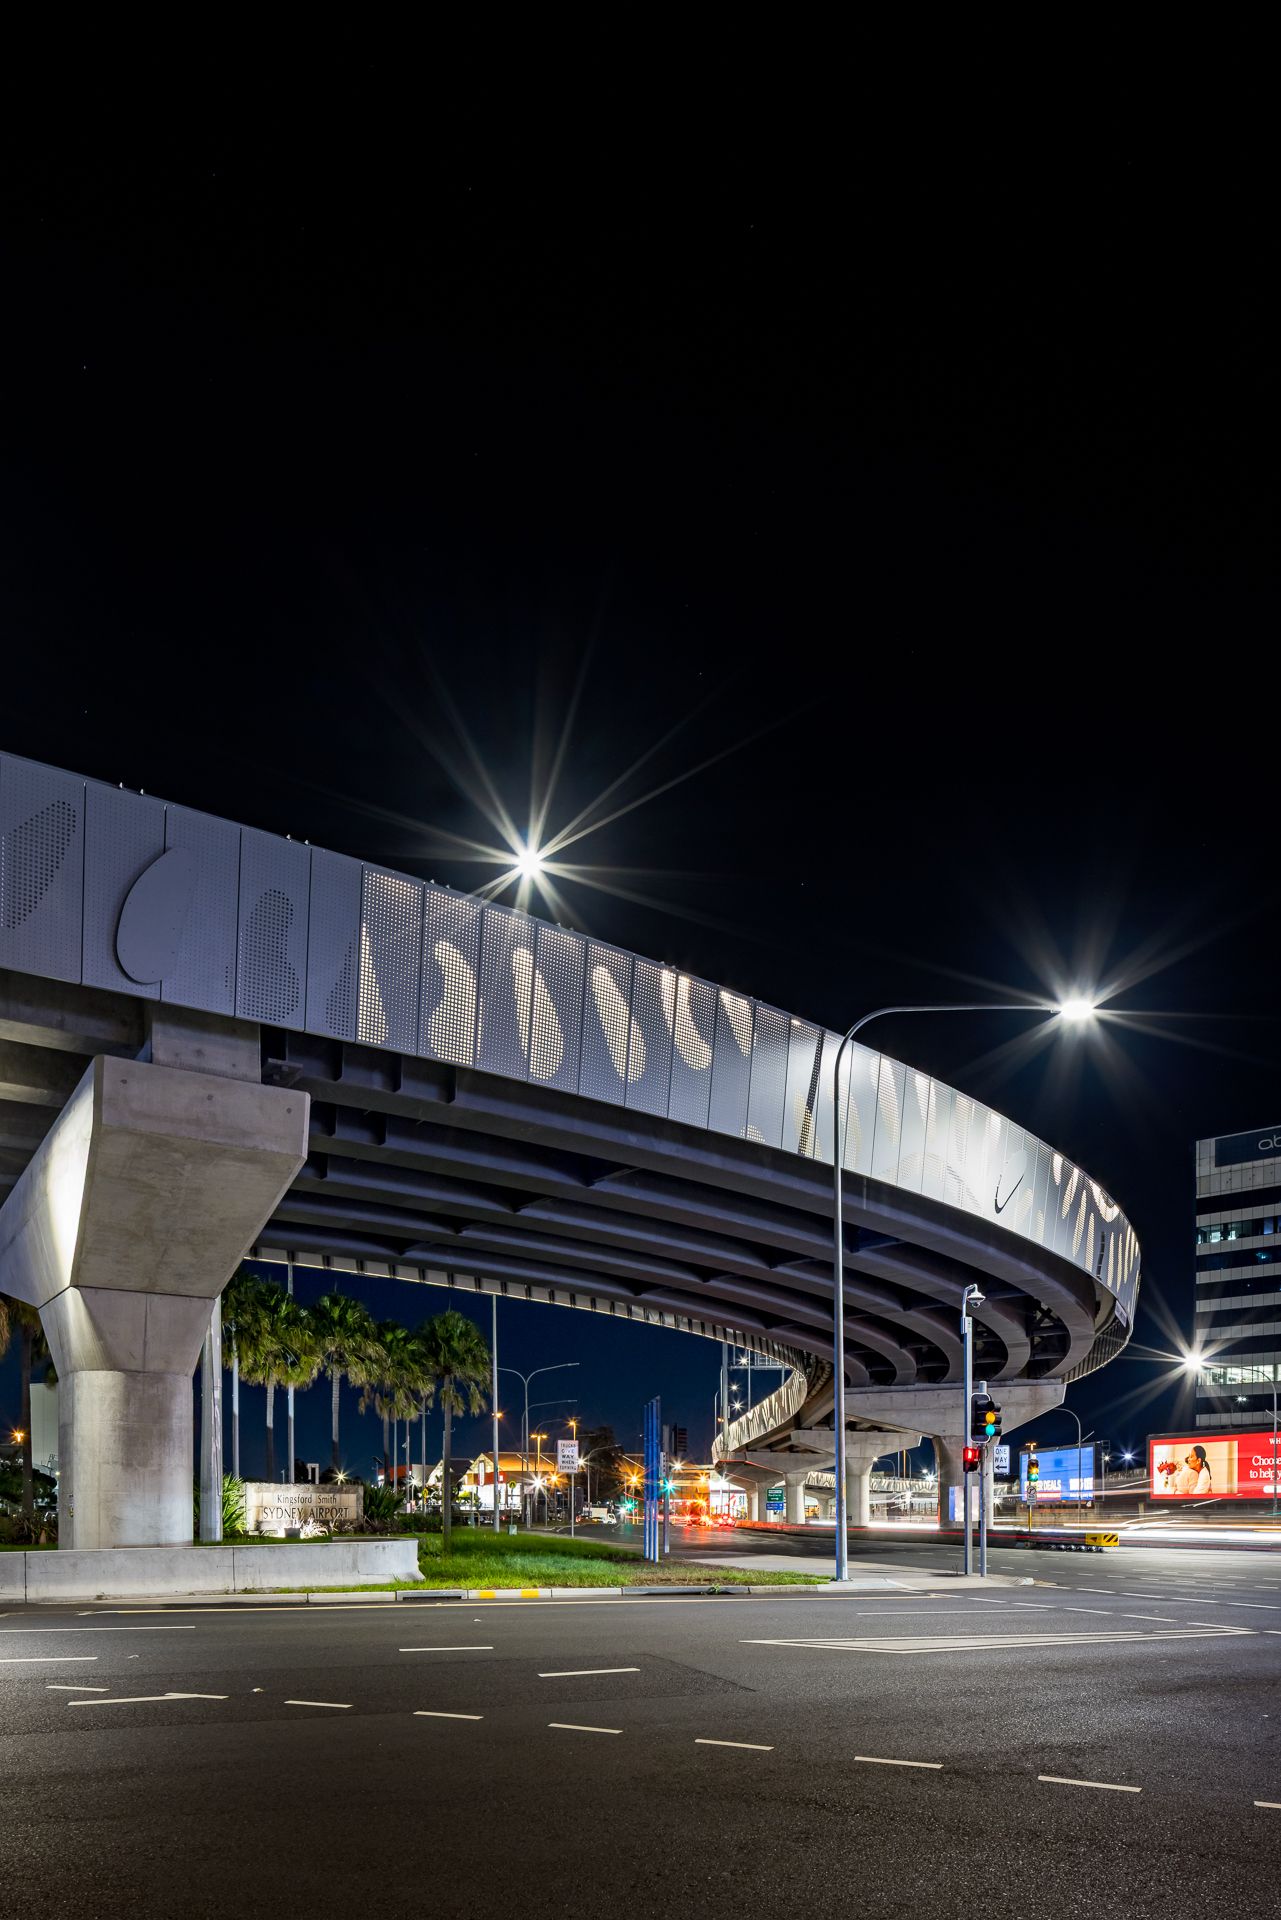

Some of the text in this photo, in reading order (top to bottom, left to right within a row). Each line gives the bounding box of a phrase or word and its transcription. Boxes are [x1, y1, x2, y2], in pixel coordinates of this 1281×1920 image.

[995, 1447, 1007, 1455] ONE
[1249, 1469, 1258, 1479] to
[1043, 1479, 1062, 1491] DEALS
[277, 1494, 337, 1504] Kingsford Smith
[263, 1507, 348, 1520] SYDNEY AIRPORT
